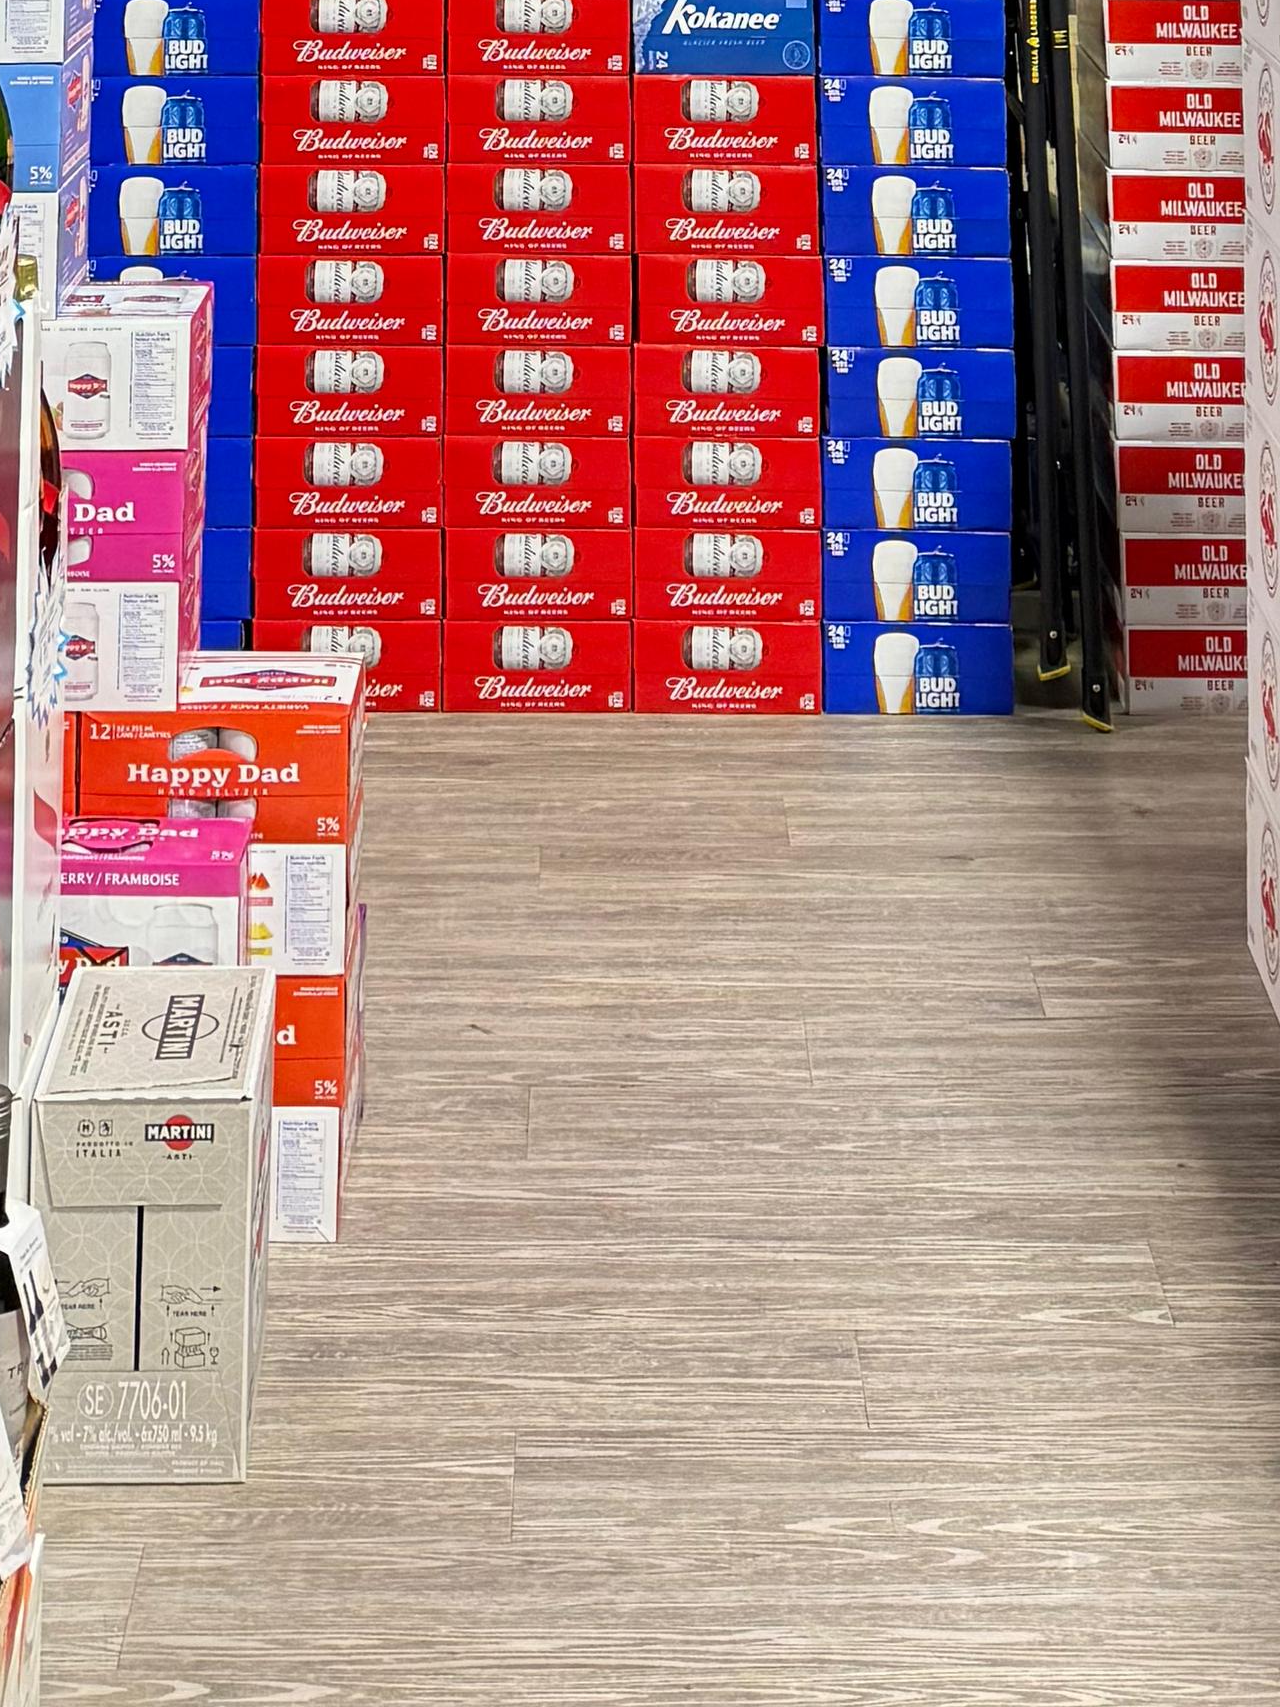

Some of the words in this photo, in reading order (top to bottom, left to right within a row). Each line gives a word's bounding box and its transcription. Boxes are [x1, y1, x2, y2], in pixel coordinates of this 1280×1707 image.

[664, 127, 778, 150] Budweiser
[478, 308, 592, 331] Budweiser
[74, 502, 136, 522] Dad
[152, 554, 175, 570] 5%
[666, 677, 782, 700] Budweiser
[90, 724, 110, 740] 12
[128, 763, 231, 785] Happy
[238, 763, 300, 783] Dad
[316, 817, 340, 832] 5%
[105, 873, 179, 886] FRAMBOISE
[159, 995, 202, 1059] MARTINI
[147, 1125, 212, 1141] MARTINI
[117, 1381, 186, 1420] 7706-01
